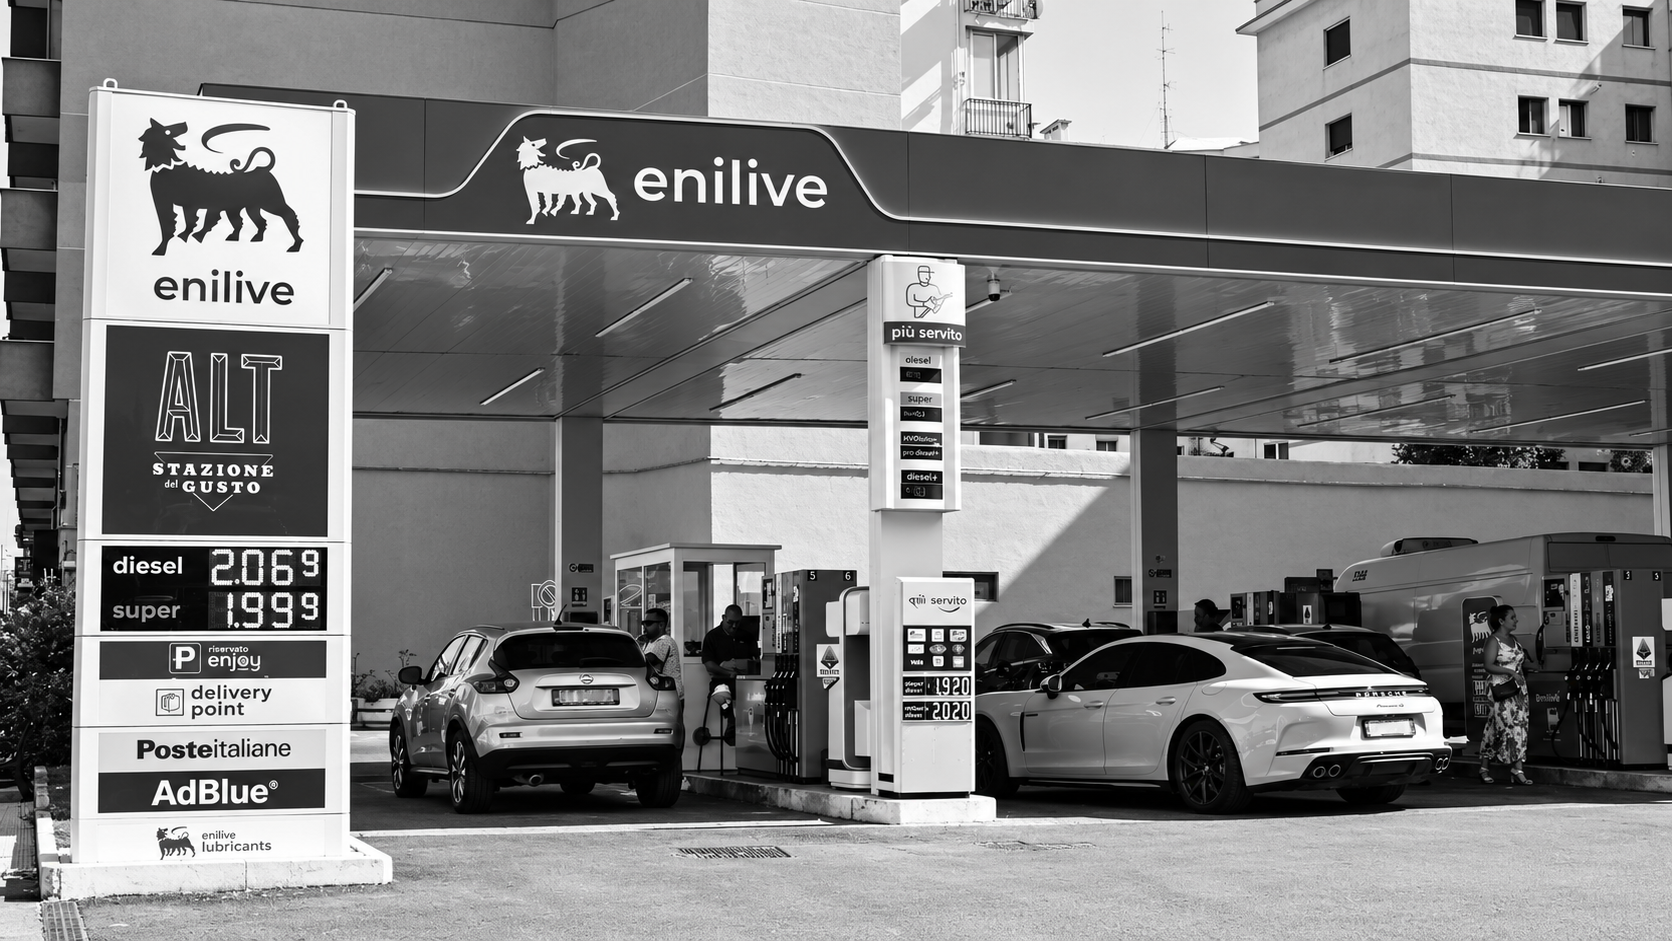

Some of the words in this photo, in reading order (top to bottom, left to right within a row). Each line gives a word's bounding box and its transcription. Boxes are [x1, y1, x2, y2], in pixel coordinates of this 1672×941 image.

[633, 156, 828, 209] enilive
[153, 269, 295, 306] enilive
[891, 325, 915, 341] più
[919, 327, 963, 342] servito
[154, 350, 283, 444] ALT
[907, 395, 933, 404] super
[152, 462, 274, 478] STAZIONE
[164, 478, 179, 489] del
[182, 481, 261, 494] GUSTO
[112, 556, 183, 575] diesel
[211, 548, 320, 586] 2.069
[809, 571, 816, 580] 5
[845, 571, 852, 580] 6
[930, 595, 967, 605] servito
[112, 604, 181, 623] super
[175, 646, 196, 670] P
[207, 653, 261, 672] enjoy
[191, 685, 272, 702] delivery
[191, 701, 245, 720] point
[136, 738, 291, 760] Posteitaliane
[201, 830, 236, 840] enilive
[201, 840, 272, 853] lubricants
